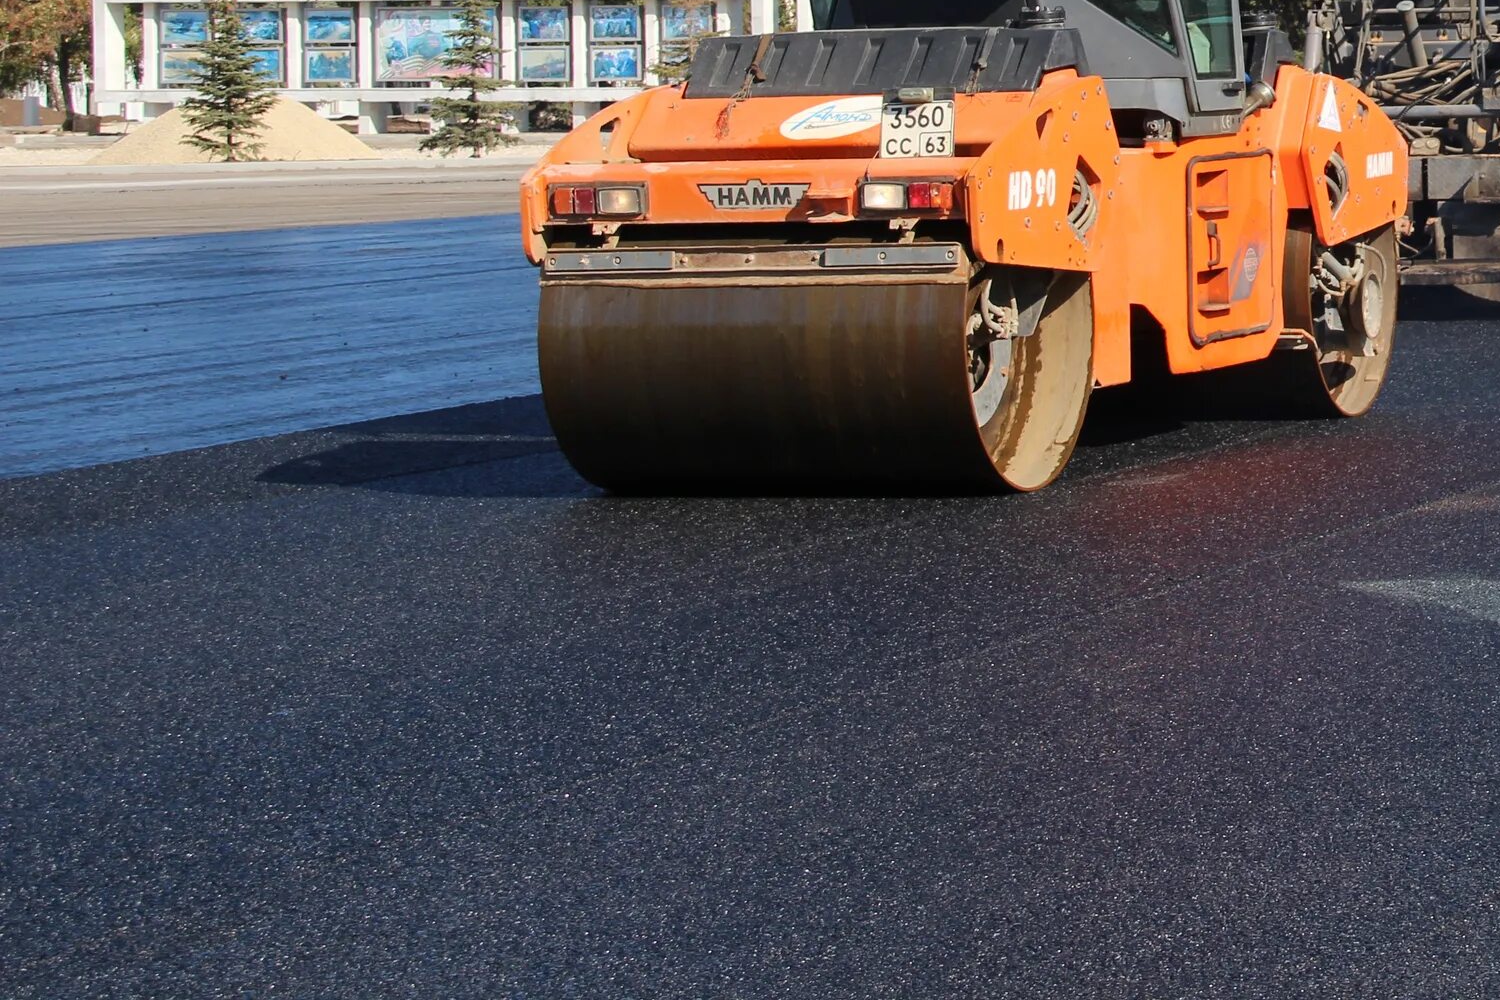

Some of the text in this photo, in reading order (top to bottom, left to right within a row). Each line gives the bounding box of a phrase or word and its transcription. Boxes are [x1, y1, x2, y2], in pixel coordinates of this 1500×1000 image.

[890, 105, 945, 129] 3560
[925, 136, 946, 154] 63
[1366, 151, 1393, 179] HAMM
[717, 185, 792, 207] HAMM
[1008, 168, 1055, 209] HD 90
